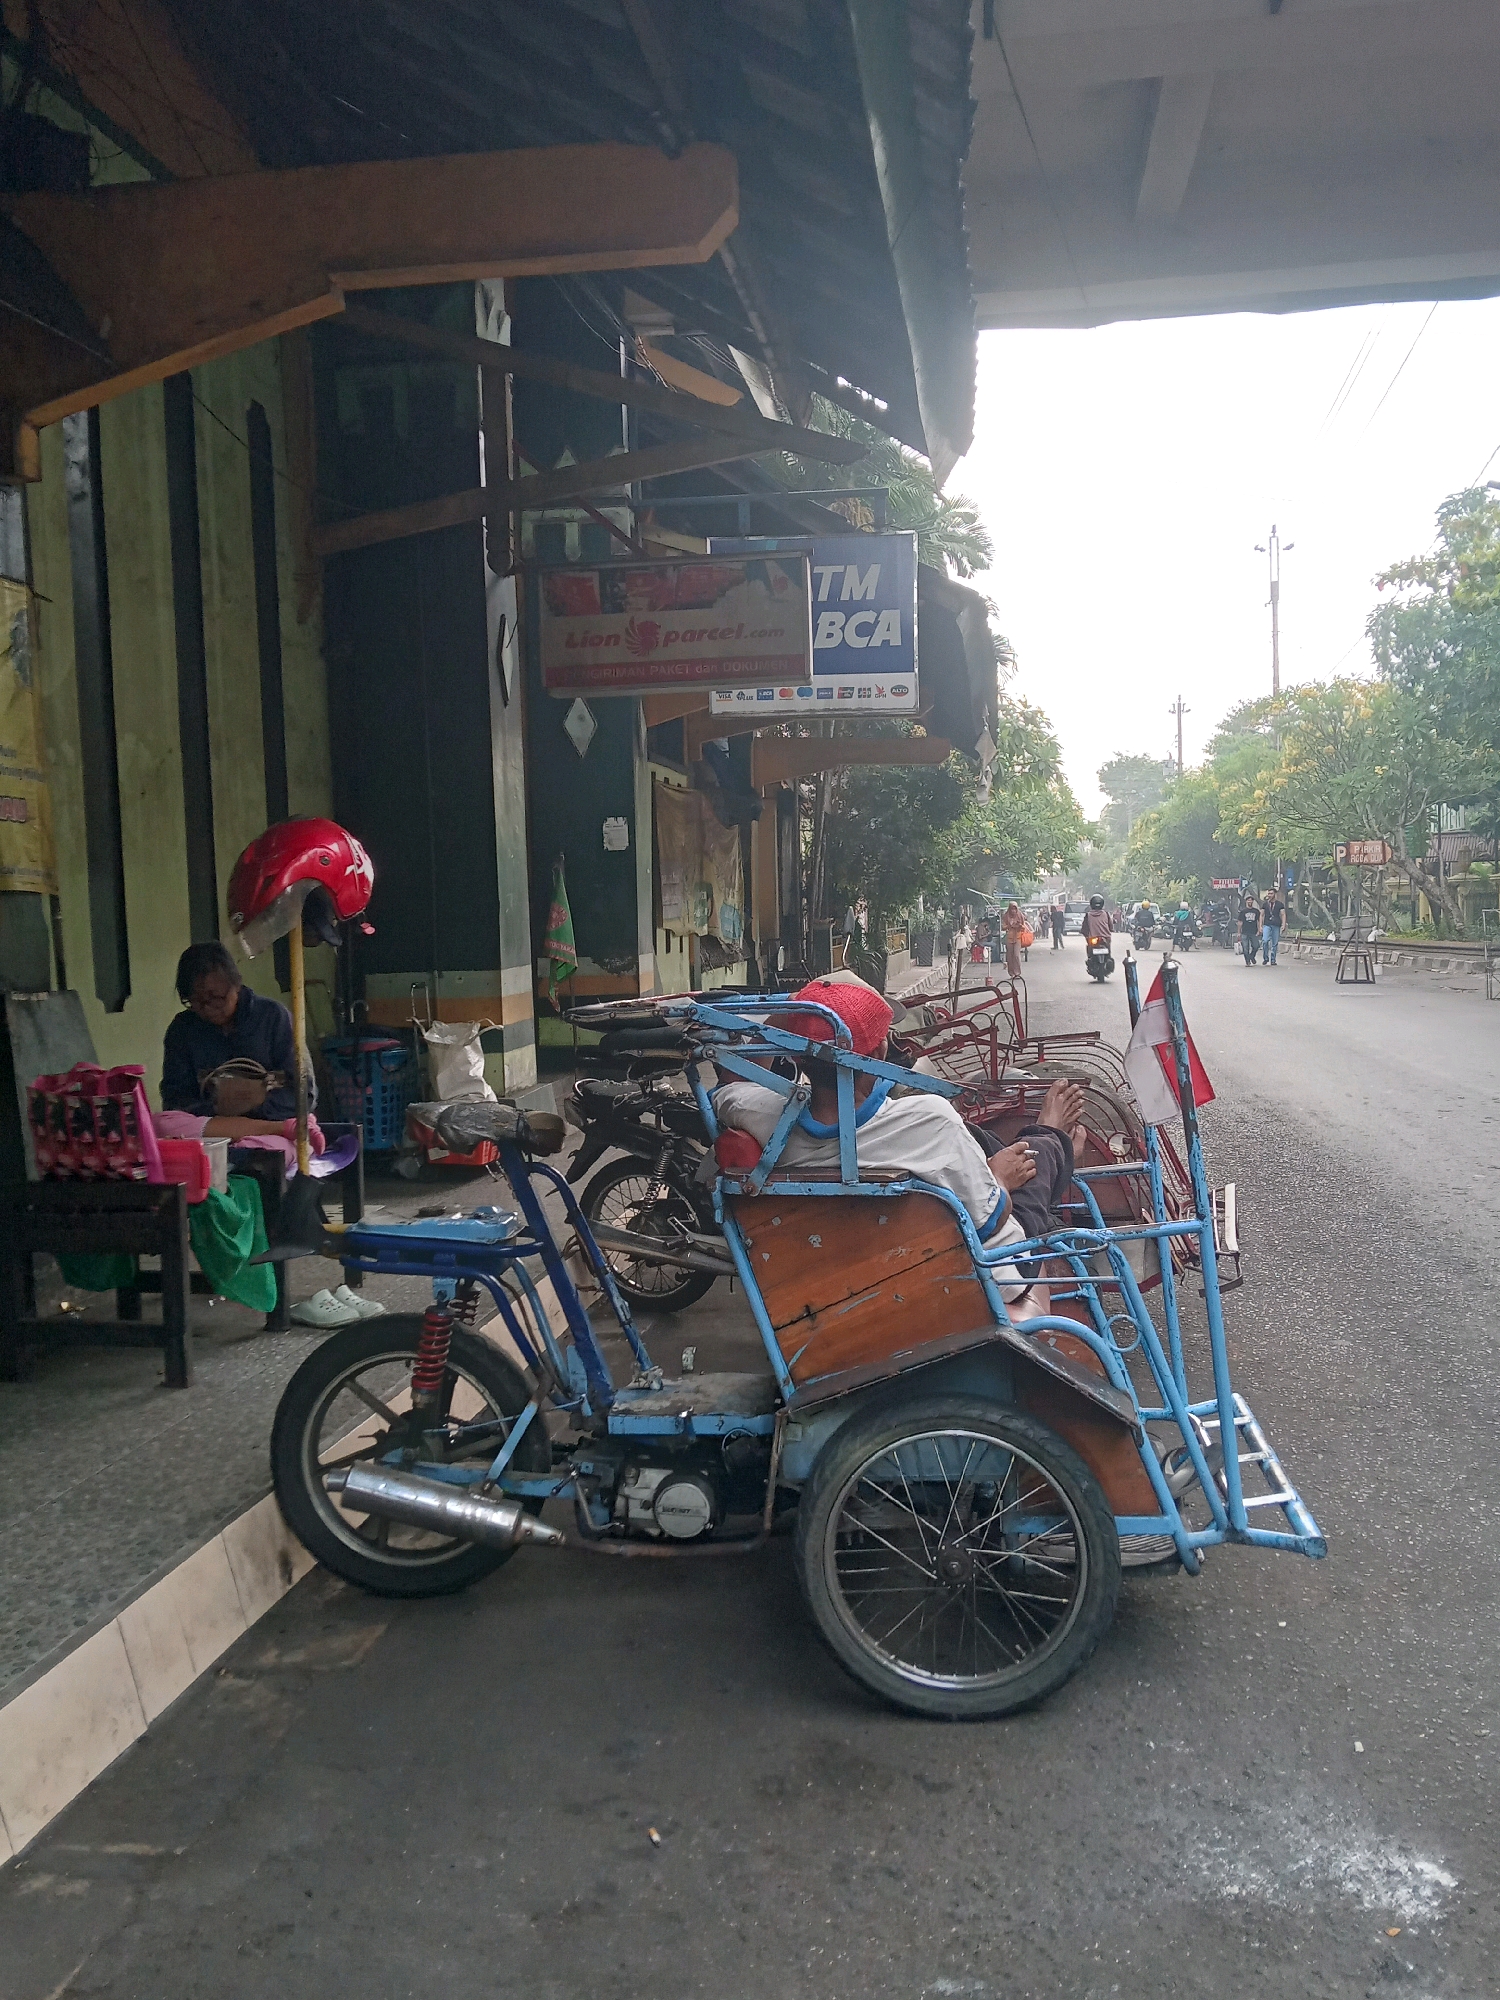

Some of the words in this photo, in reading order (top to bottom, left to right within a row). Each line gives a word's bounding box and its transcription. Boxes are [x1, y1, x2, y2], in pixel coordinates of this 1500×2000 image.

[811, 564, 881, 602] TM
[814, 609, 902, 649] BCA
[565, 631, 620, 649] Lion
[650, 663, 690, 676] PAKET
[696, 662, 718, 675] dan
[723, 660, 788, 672] DOKUMEN
[1336, 845, 1347, 863] P
